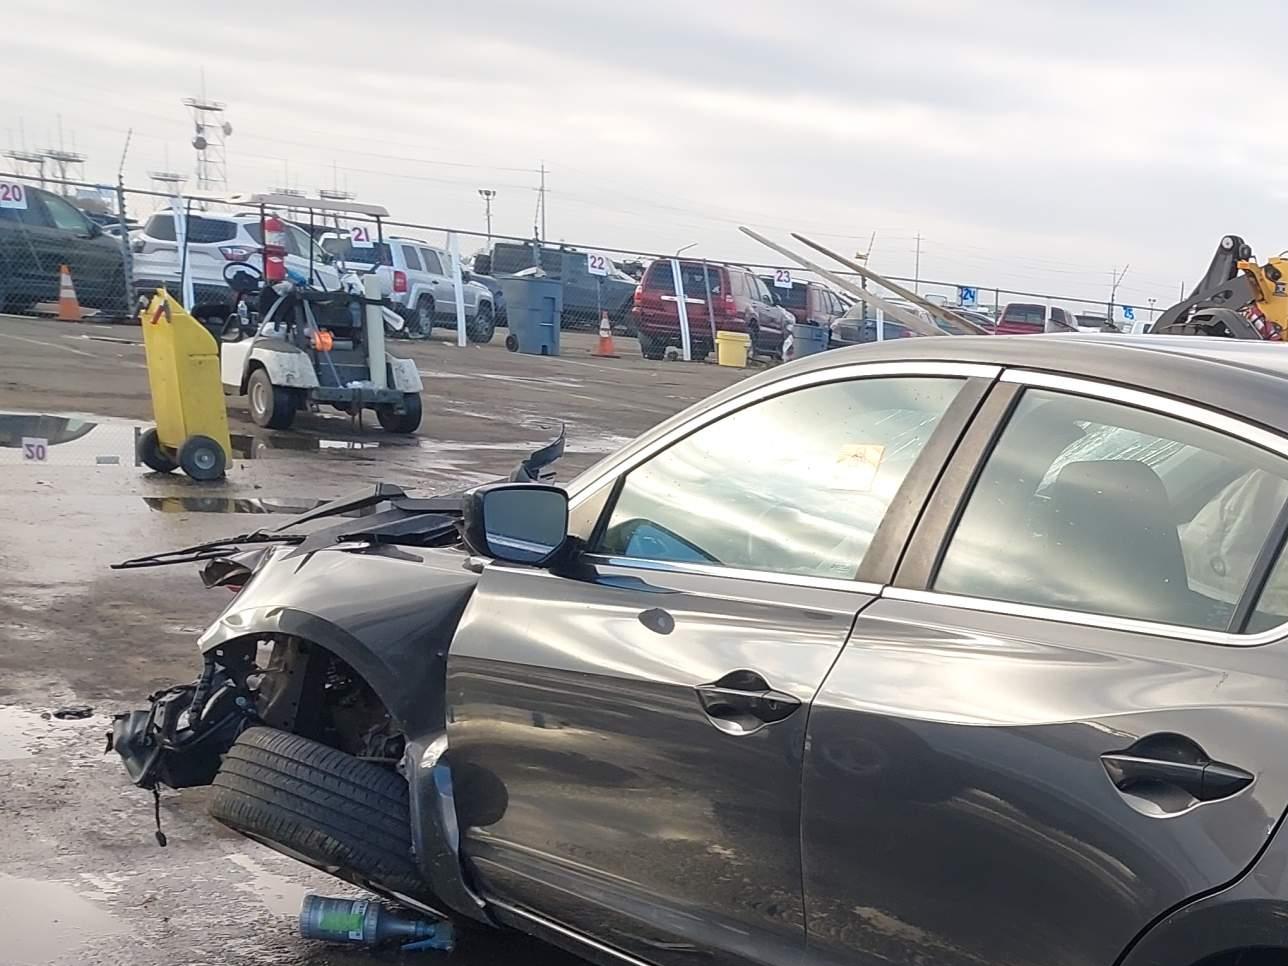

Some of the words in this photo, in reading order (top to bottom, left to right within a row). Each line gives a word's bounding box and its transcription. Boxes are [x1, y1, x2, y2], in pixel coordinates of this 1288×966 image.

[0, 184, 22, 202] 20
[352, 227, 370, 242] 21
[589, 255, 606, 270] 22
[776, 270, 791, 283] 23
[963, 288, 976, 303] 24
[1122, 305, 1135, 321] 25
